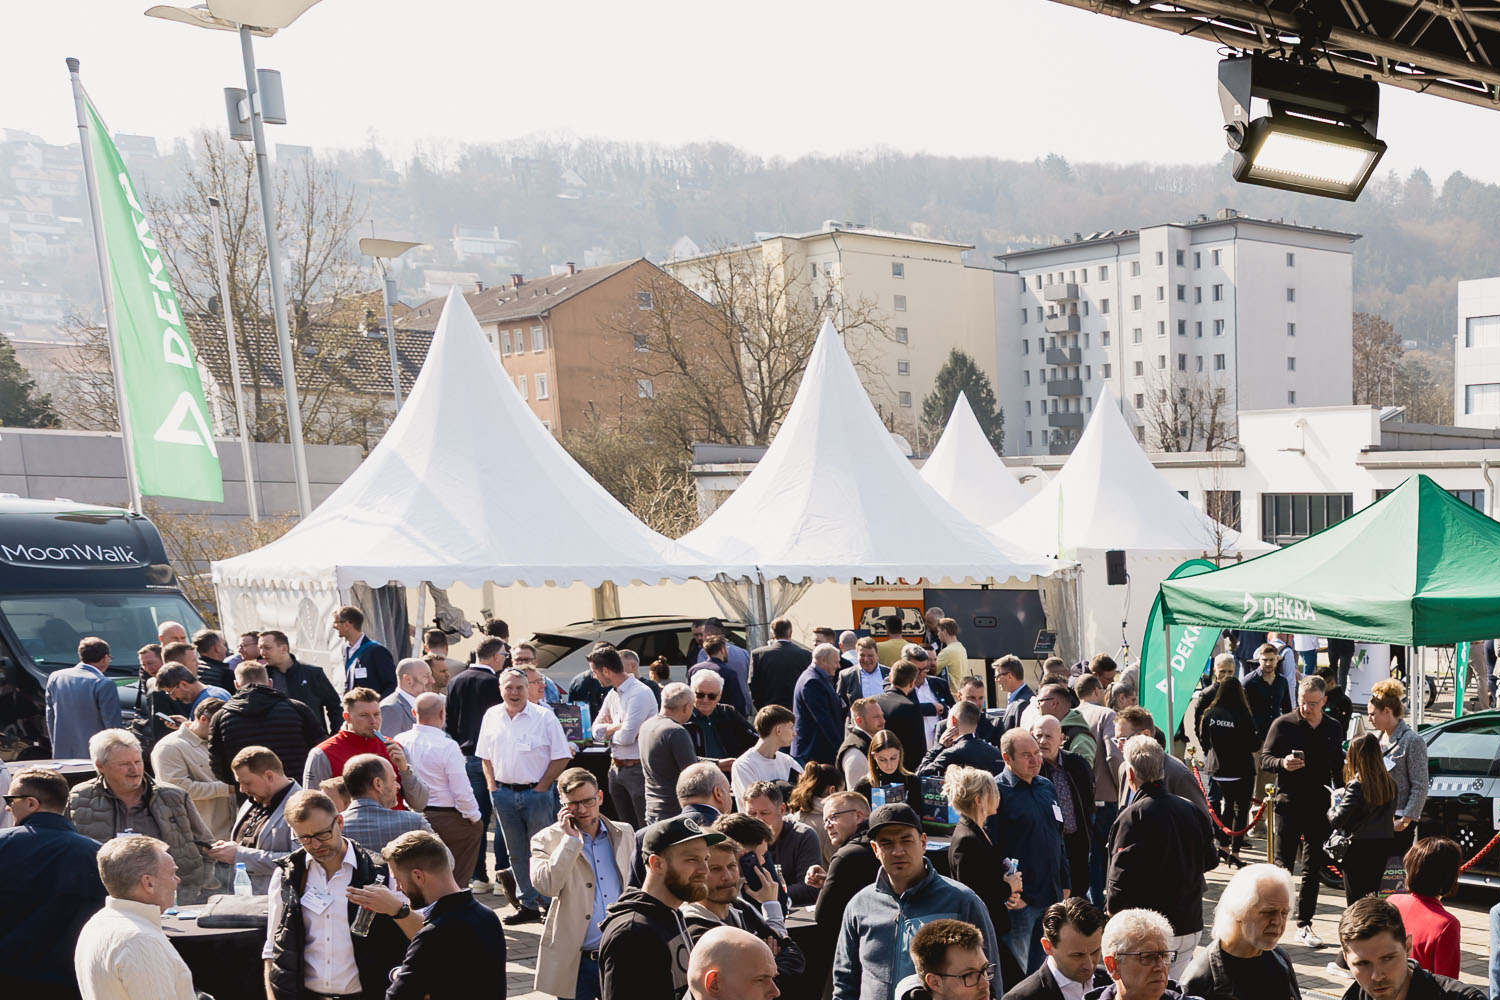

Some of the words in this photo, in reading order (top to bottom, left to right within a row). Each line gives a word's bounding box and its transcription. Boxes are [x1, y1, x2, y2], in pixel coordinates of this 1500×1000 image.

[1, 544, 140, 563] MoonWalk
[1263, 597, 1317, 622] DEKRA
[1216, 719, 1235, 729] DEKRA
